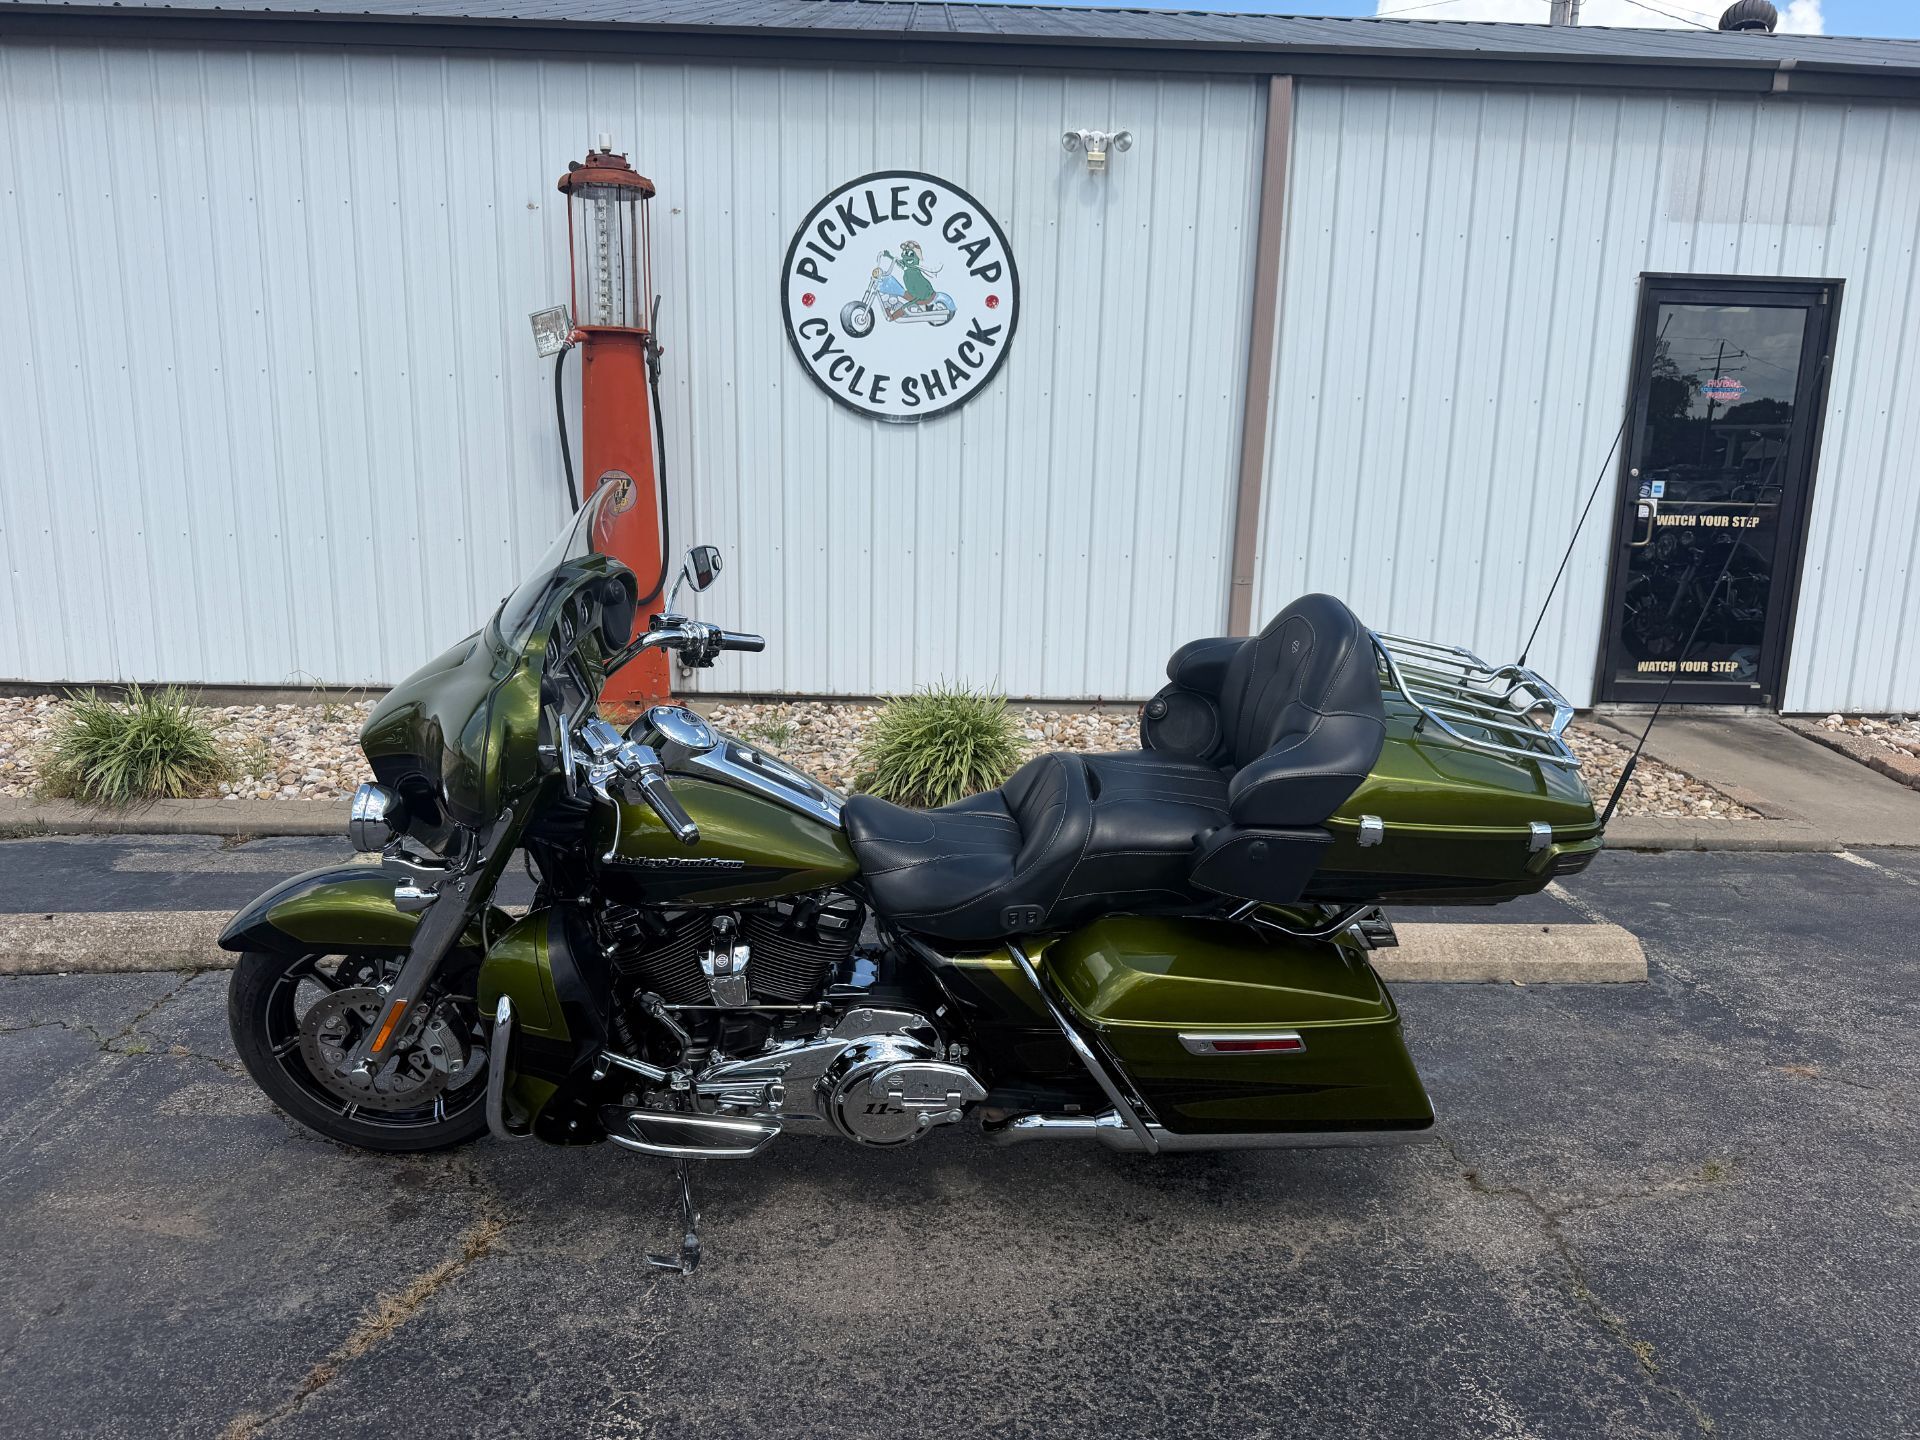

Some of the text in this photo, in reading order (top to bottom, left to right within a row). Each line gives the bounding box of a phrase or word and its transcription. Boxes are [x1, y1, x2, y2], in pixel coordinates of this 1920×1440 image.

[796, 186, 1002, 284] PICKLES GAP
[799, 317, 1002, 407] CYCLE SHACK
[1656, 514, 1760, 528] WATCH YOUR STEP
[1637, 661, 1739, 673] WATCH YOUR STEP
